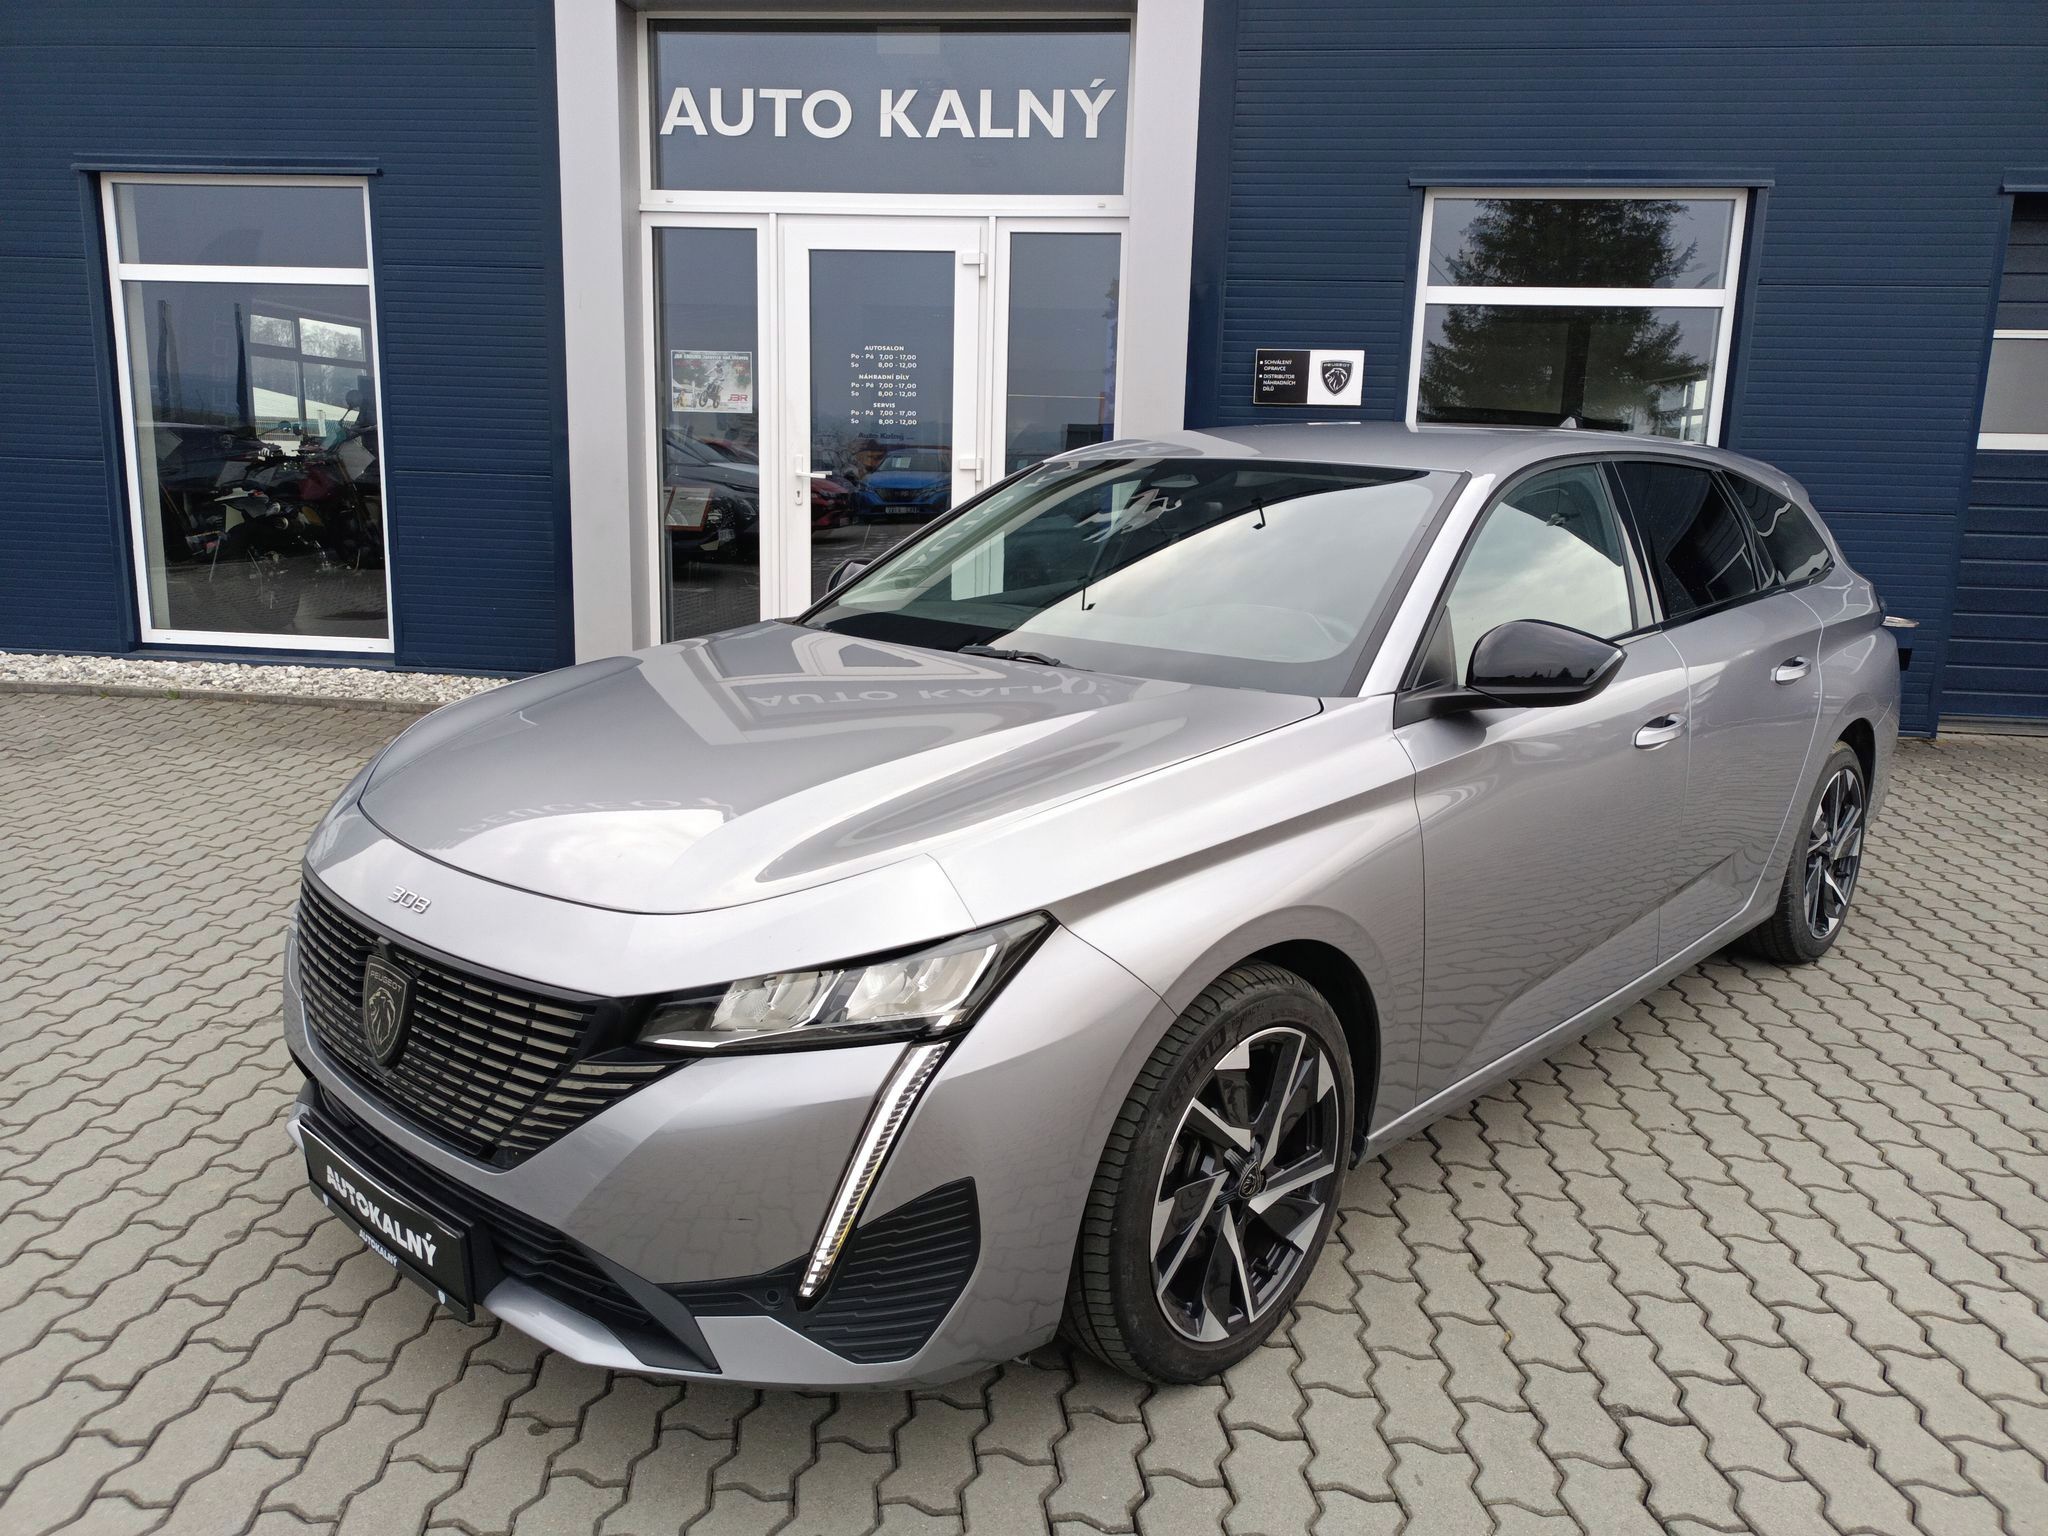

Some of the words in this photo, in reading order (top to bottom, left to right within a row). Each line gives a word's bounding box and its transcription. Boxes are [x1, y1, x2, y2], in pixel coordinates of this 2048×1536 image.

[659, 87, 853, 139] AUTO
[879, 78, 1117, 139] KALNÝ
[387, 885, 432, 914] 308
[369, 970, 402, 993] PEUGEOT
[326, 1164, 437, 1267] AUTOKALNÝ
[359, 1229, 398, 1267] AUTOKALNÝ
